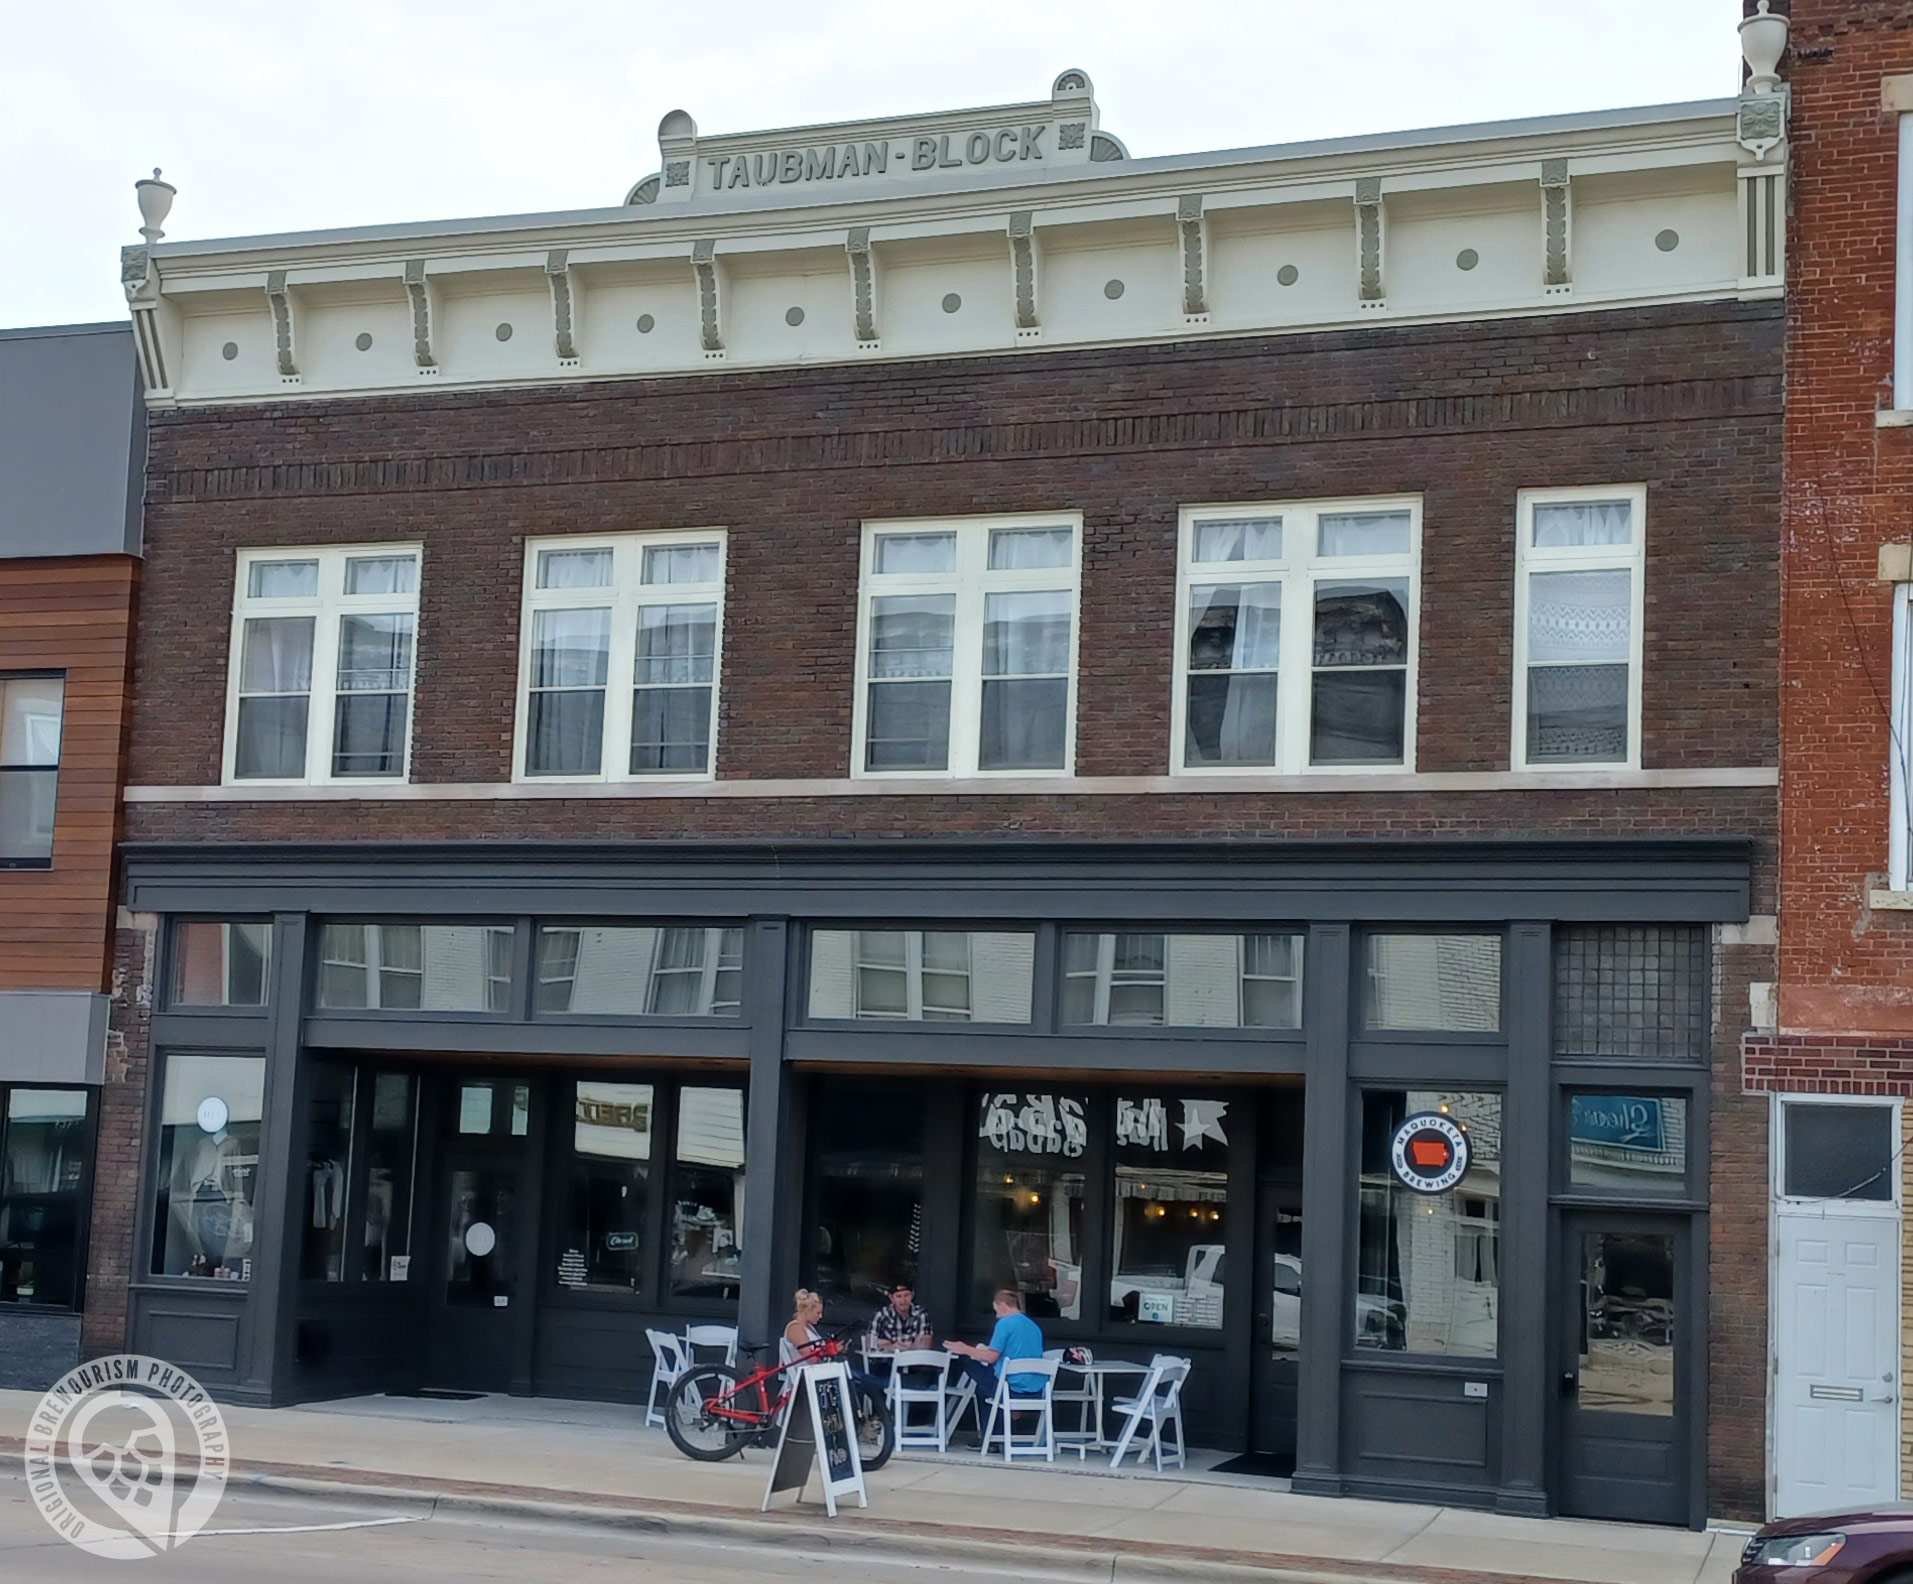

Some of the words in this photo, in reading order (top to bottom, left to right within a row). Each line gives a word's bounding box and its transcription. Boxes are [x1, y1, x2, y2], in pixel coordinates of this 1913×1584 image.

[1397, 1118, 1463, 1148] MAQUOKETA
[1403, 1171, 1456, 1188] BREWING
[1143, 1302, 1168, 1311] OPEN
